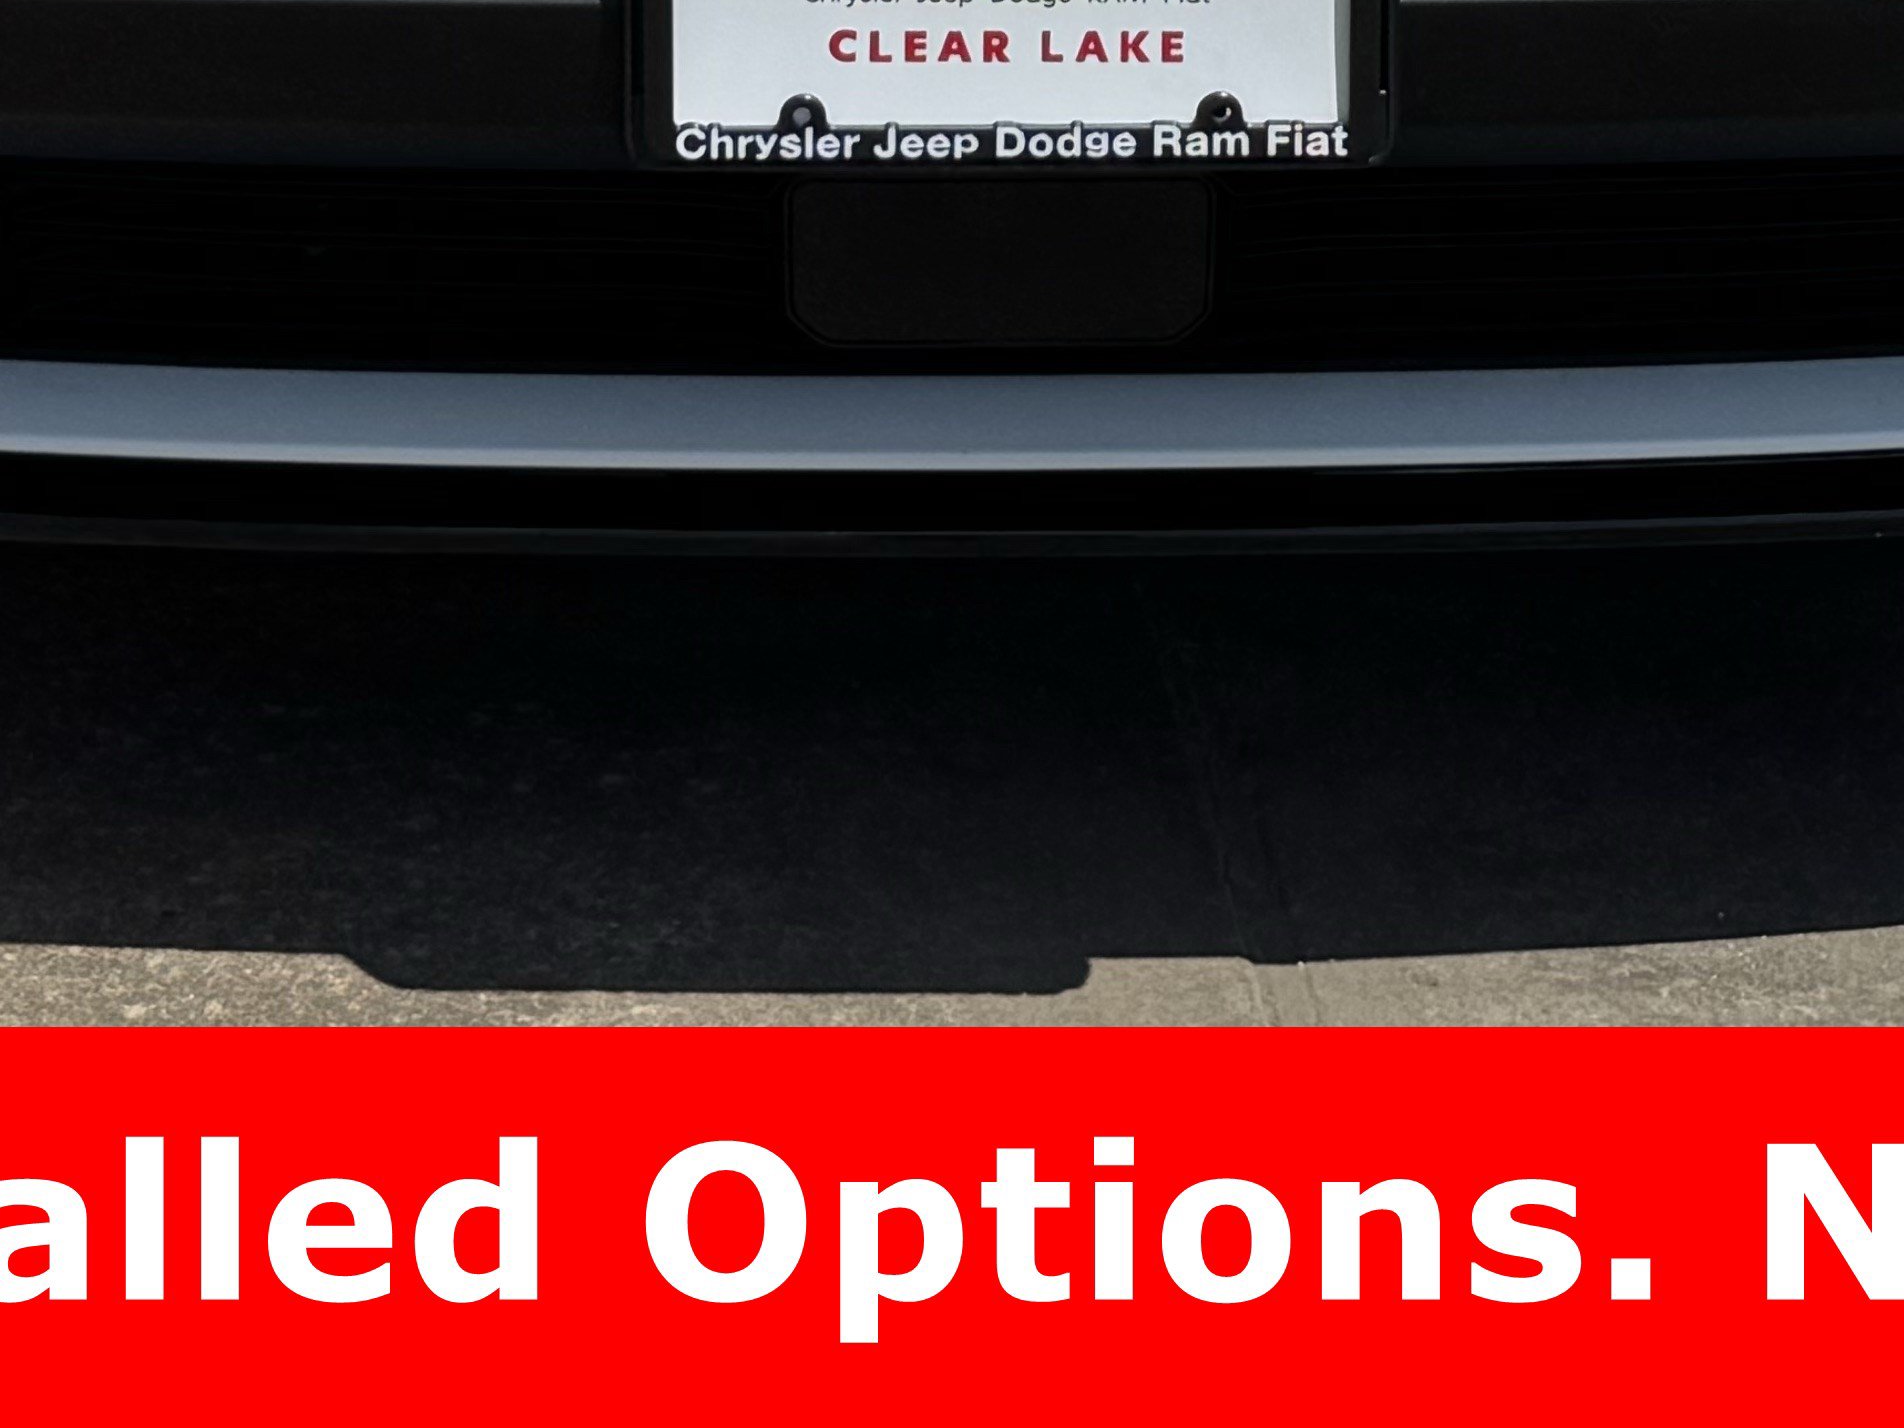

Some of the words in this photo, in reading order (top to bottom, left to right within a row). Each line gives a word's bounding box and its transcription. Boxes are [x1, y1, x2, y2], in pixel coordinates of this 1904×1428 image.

[828, 30, 1010, 63] CLEAR
[1041, 30, 1186, 63] LAKE
[675, 124, 860, 162] Chrysler
[873, 124, 980, 161] Jeep
[995, 124, 1137, 160] Dodge
[1152, 124, 1251, 159] Ram
[1266, 123, 1348, 158] Fiat
